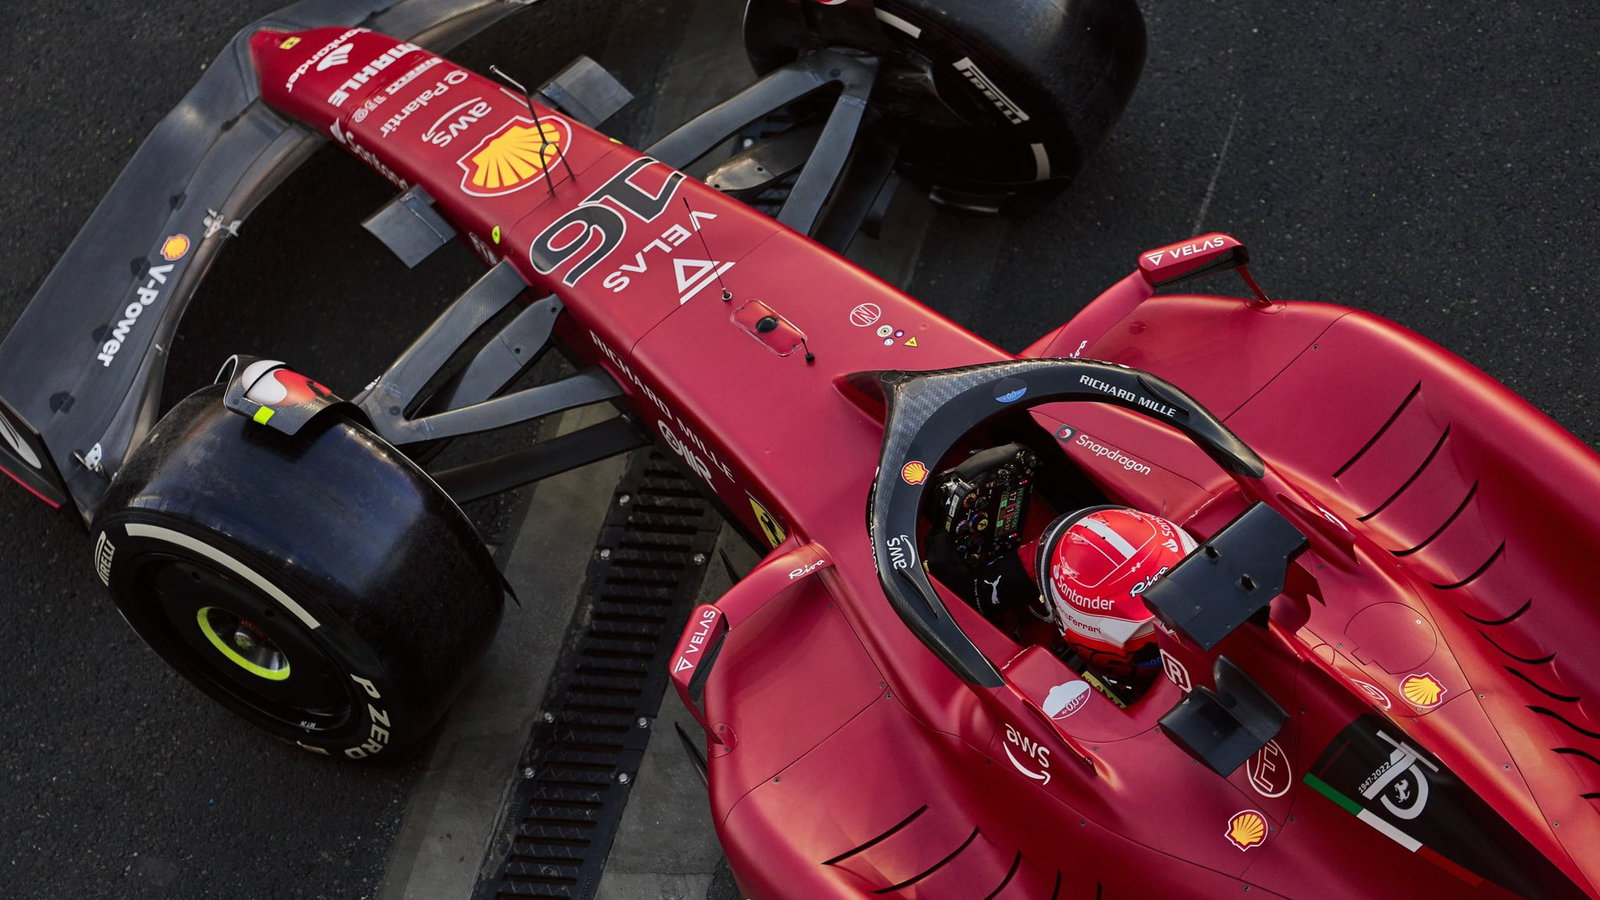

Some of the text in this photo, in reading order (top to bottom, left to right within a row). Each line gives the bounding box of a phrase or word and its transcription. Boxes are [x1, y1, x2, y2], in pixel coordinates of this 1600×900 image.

[328, 43, 422, 107] MAHLE
[951, 56, 1030, 125] PIRELLI
[380, 82, 449, 138] Palantir
[432, 101, 493, 148] aws
[529, 156, 688, 288] 16
[602, 210, 718, 293] VELAS
[1169, 236, 1225, 260] VELAS
[97, 263, 175, 368] V-Power
[588, 329, 736, 484] RICHARD MILLE
[1079, 374, 1177, 418] RICHARD MILLE
[1075, 434, 1152, 476] Snapdragon
[94, 530, 116, 588] PIRELLI
[788, 559, 825, 580] Riva
[886, 537, 908, 571] aws
[1057, 576, 1116, 611] Santander
[1129, 566, 1169, 598] Riva
[685, 609, 717, 656] VELAS
[344, 673, 391, 759] P ZERO
[1004, 722, 1051, 769] aws
[1357, 761, 1392, 794] 1947-2022
